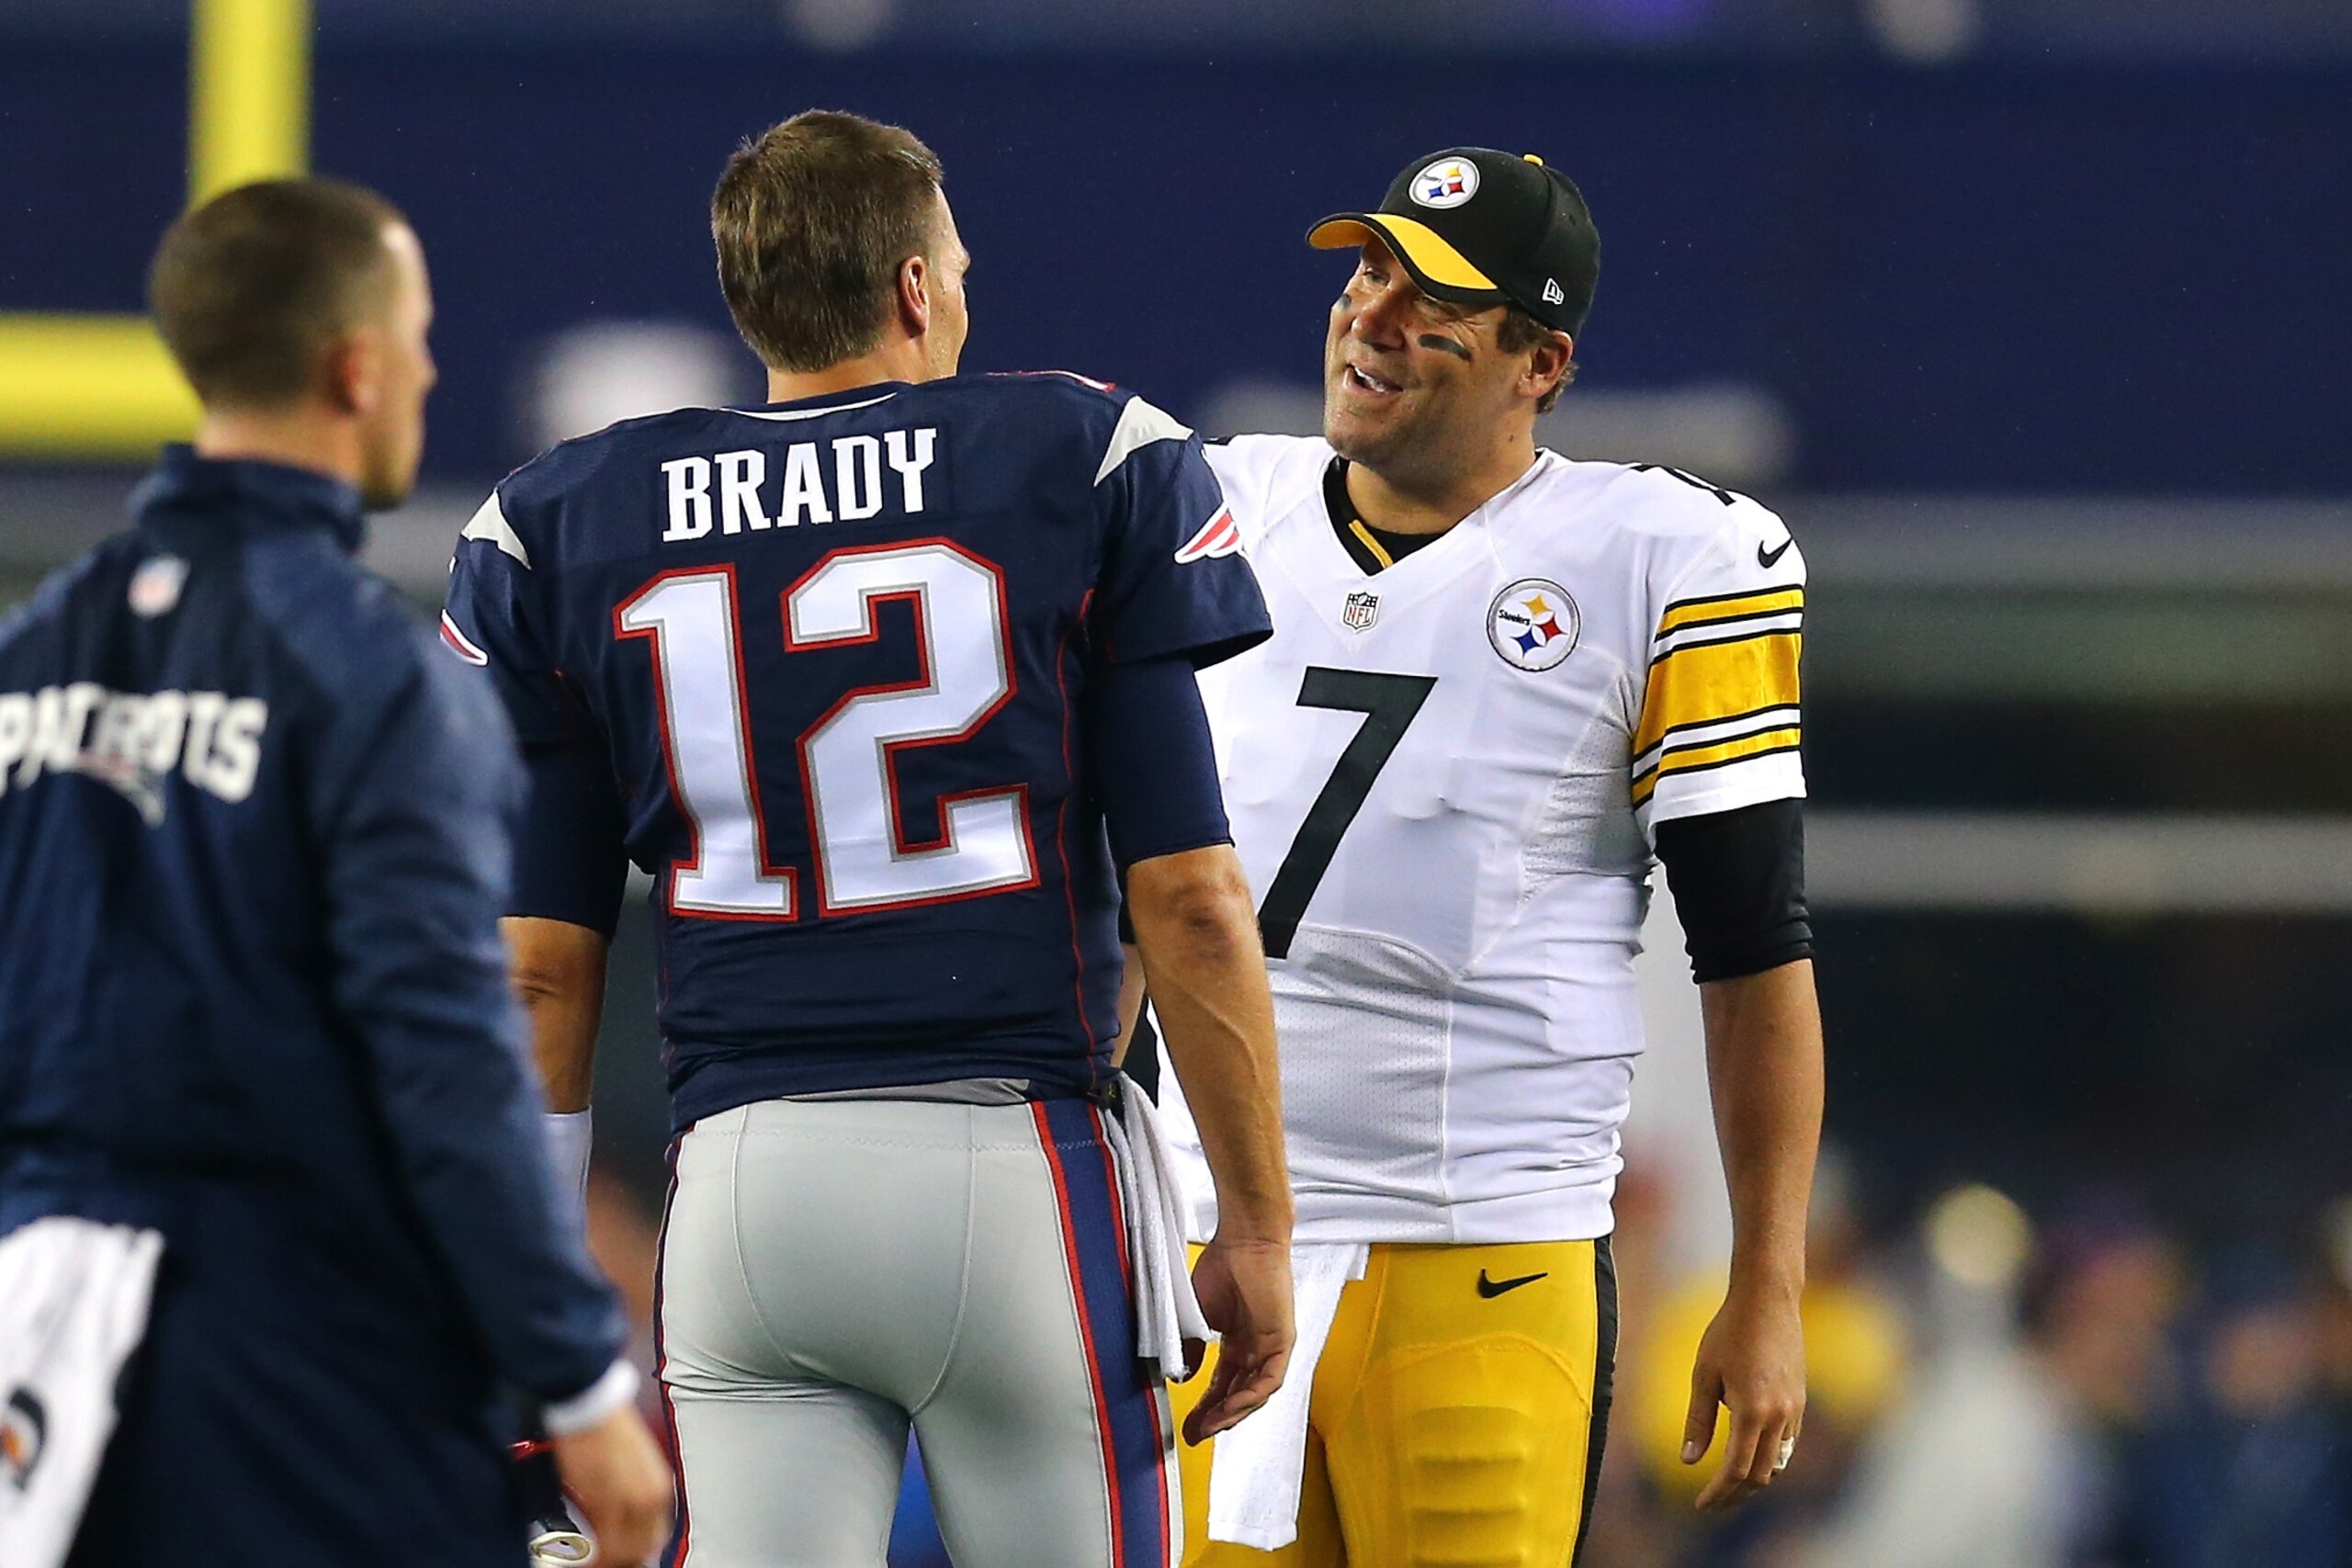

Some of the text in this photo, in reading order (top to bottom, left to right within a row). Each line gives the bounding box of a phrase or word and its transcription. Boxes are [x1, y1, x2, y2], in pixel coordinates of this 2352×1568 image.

[661, 428, 937, 542] BRADY
[1347, 605, 1372, 625] NFL
[1498, 609, 1531, 626] Steelers
[613, 536, 1041, 921] 12
[1258, 666, 1439, 960] 7
